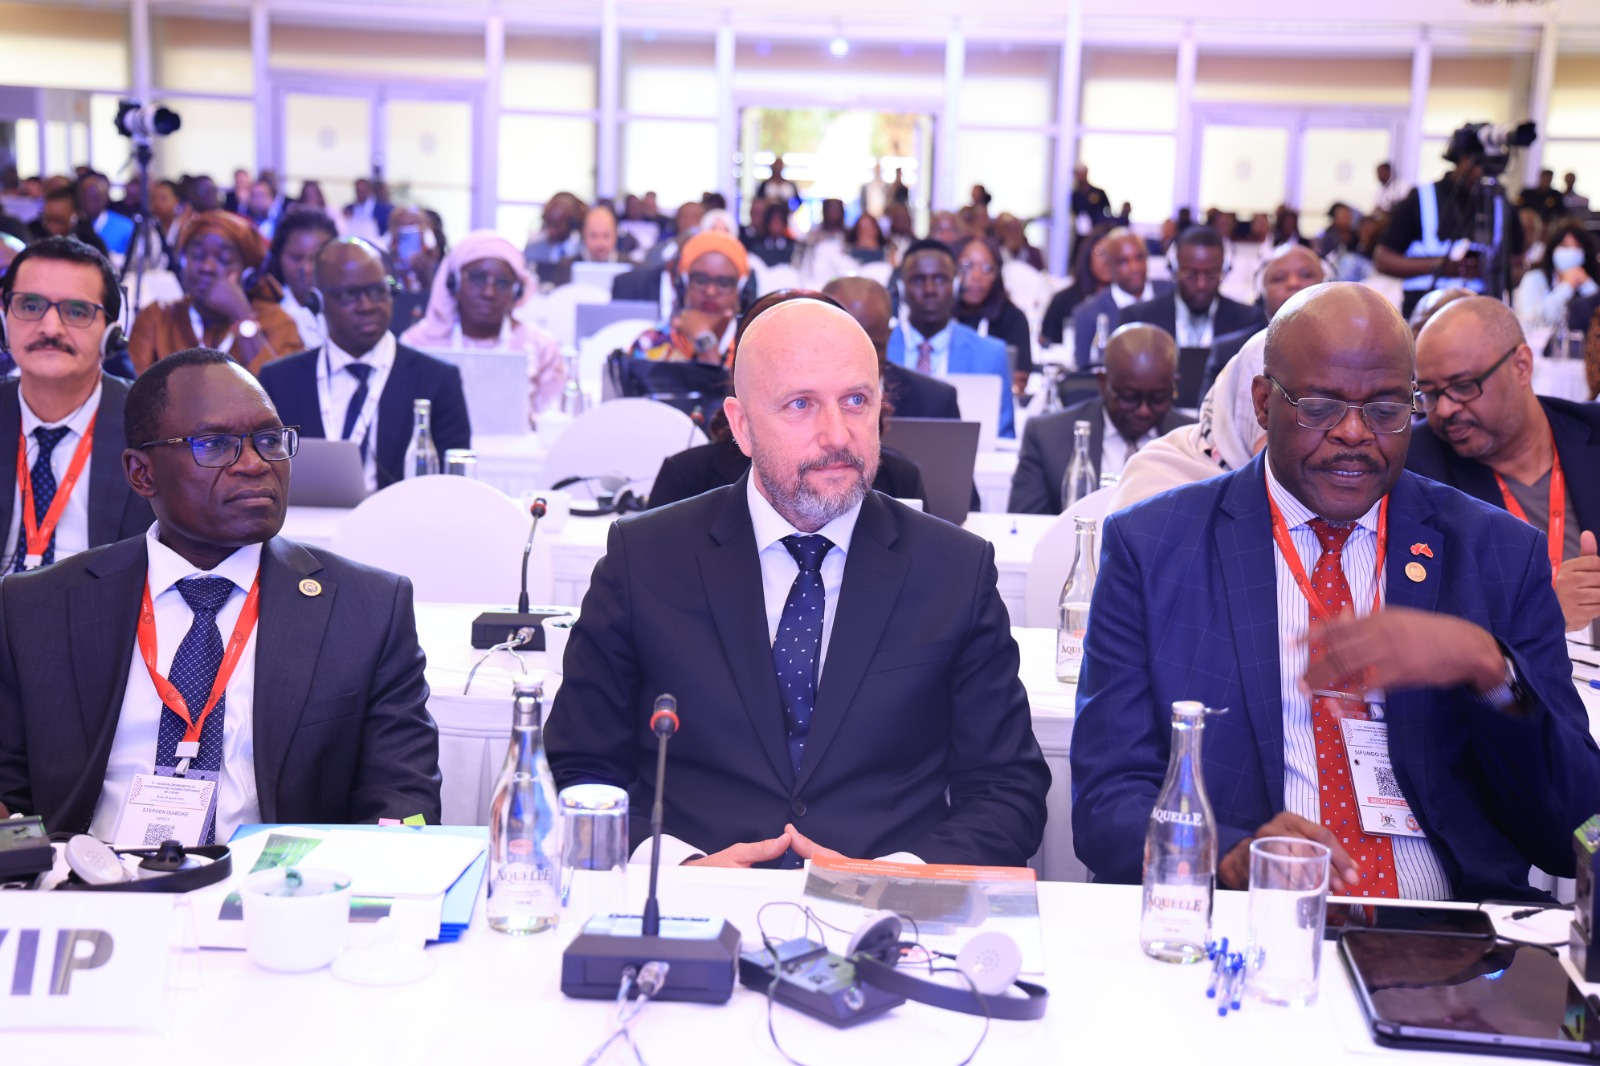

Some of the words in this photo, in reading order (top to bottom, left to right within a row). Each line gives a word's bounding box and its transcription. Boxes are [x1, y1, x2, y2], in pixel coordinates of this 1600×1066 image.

[1061, 645, 1083, 655] AQUE
[142, 807, 166, 816] STEPHEN
[0, 929, 114, 996] IP
